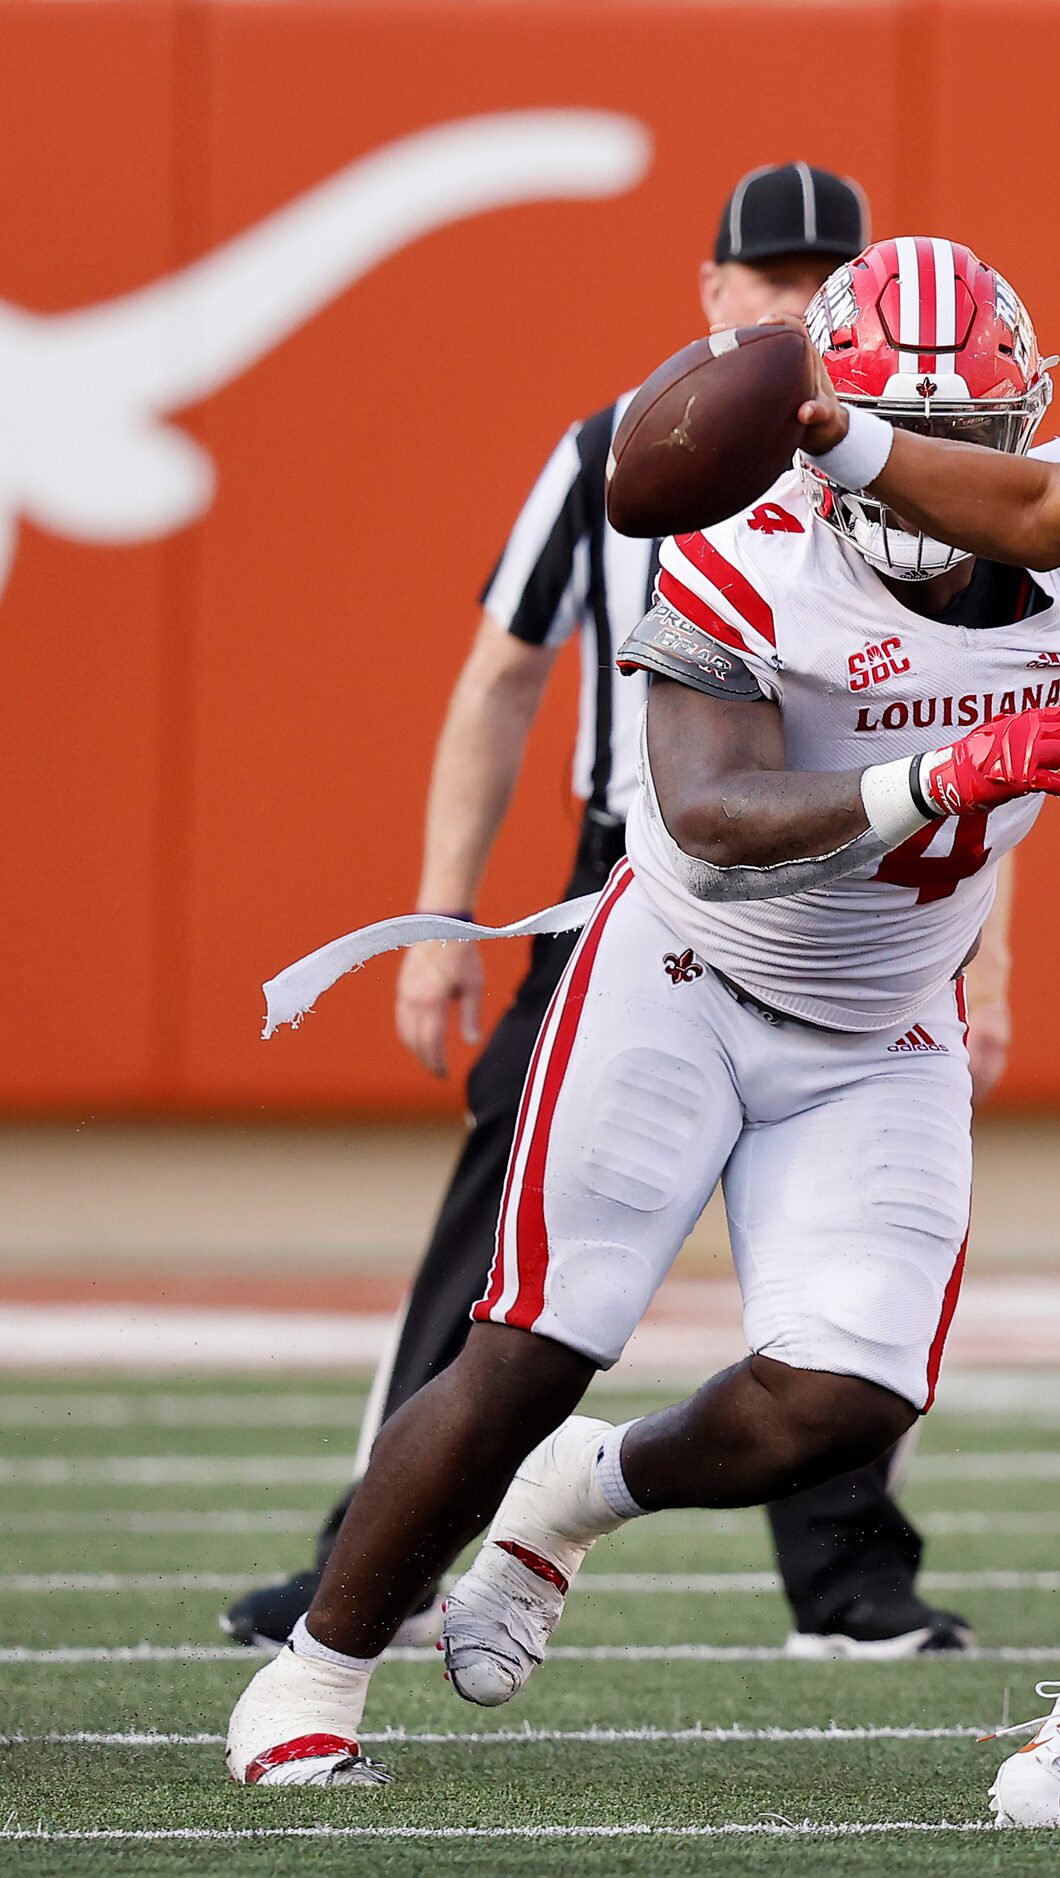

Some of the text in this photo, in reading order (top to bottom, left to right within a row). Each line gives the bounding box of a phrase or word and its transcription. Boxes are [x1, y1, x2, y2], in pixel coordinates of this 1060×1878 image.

[747, 502, 805, 534] 4
[848, 636, 911, 691] SBC
[855, 679, 1060, 731] LOUISIANA
[868, 808, 992, 905] 4
[887, 1044, 949, 1052] adidas
